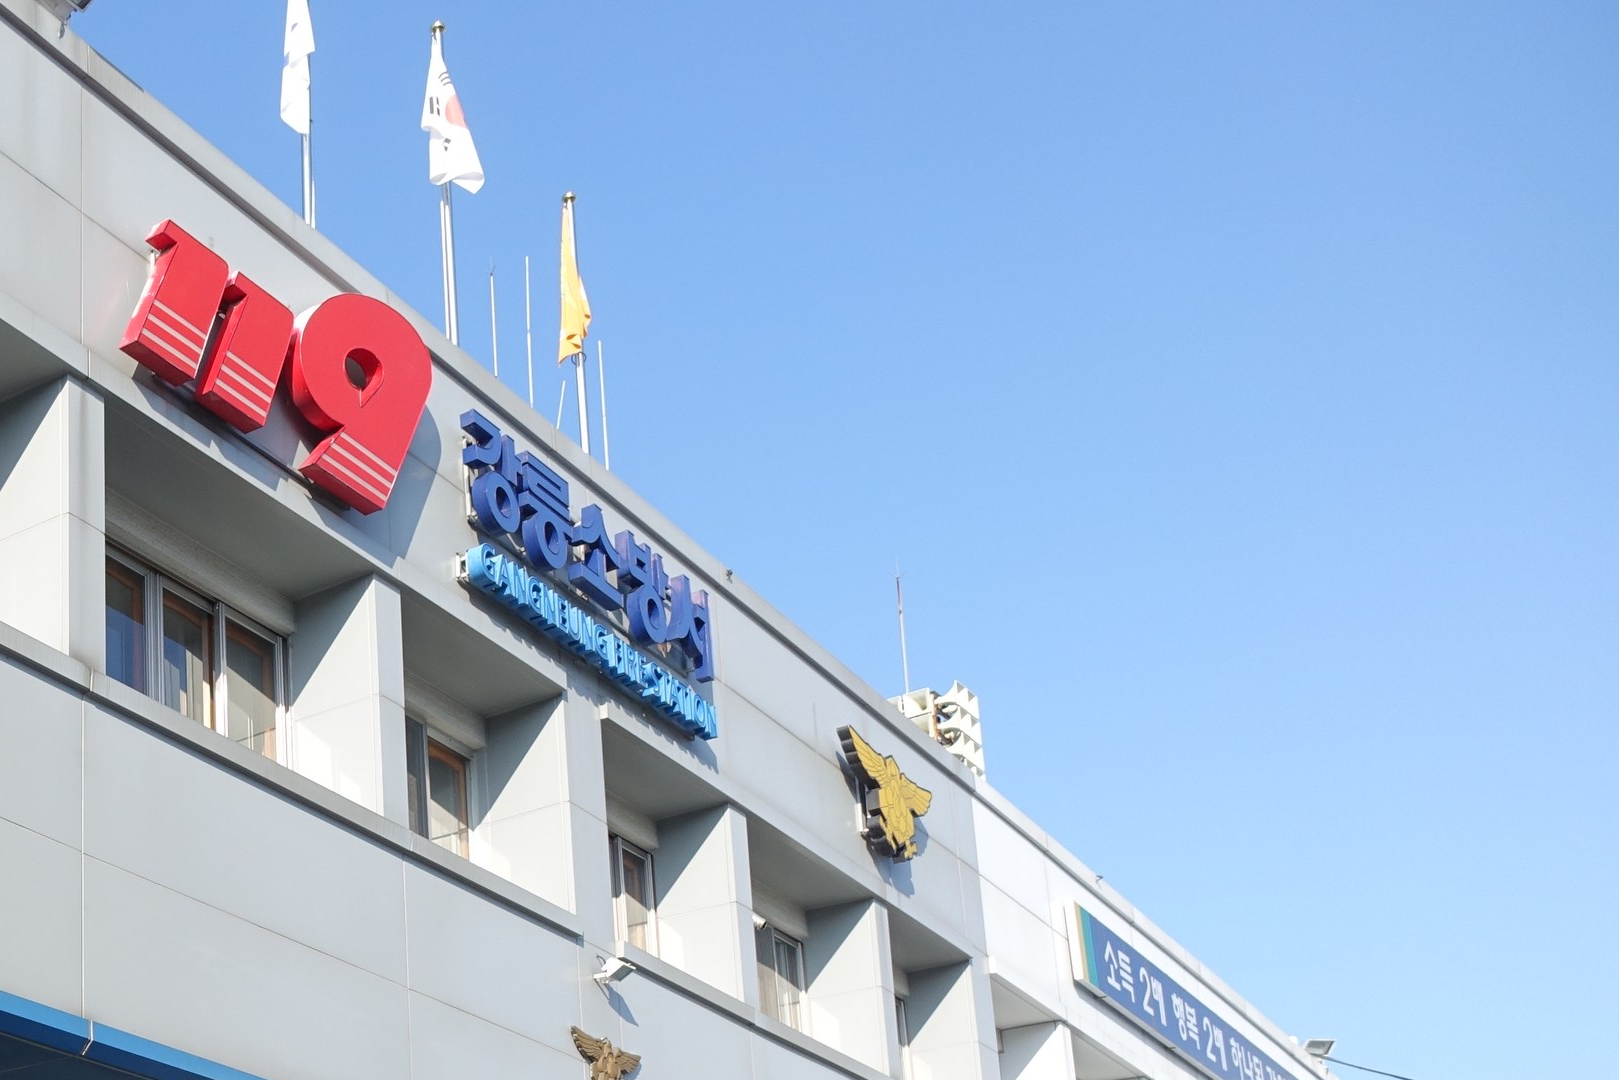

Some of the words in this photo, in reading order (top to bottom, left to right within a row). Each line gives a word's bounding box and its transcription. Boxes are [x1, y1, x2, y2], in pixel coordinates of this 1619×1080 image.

[119, 218, 433, 516] 119
[460, 408, 714, 684] 강릉소방서
[466, 542, 614, 672] GANGNEUNG
[642, 661, 718, 740] STATION
[1104, 940, 1136, 1004] 소득
[1139, 966, 1168, 1028] 2배
[1171, 992, 1201, 1051] 행복
[1203, 1016, 1228, 1073] 2배
